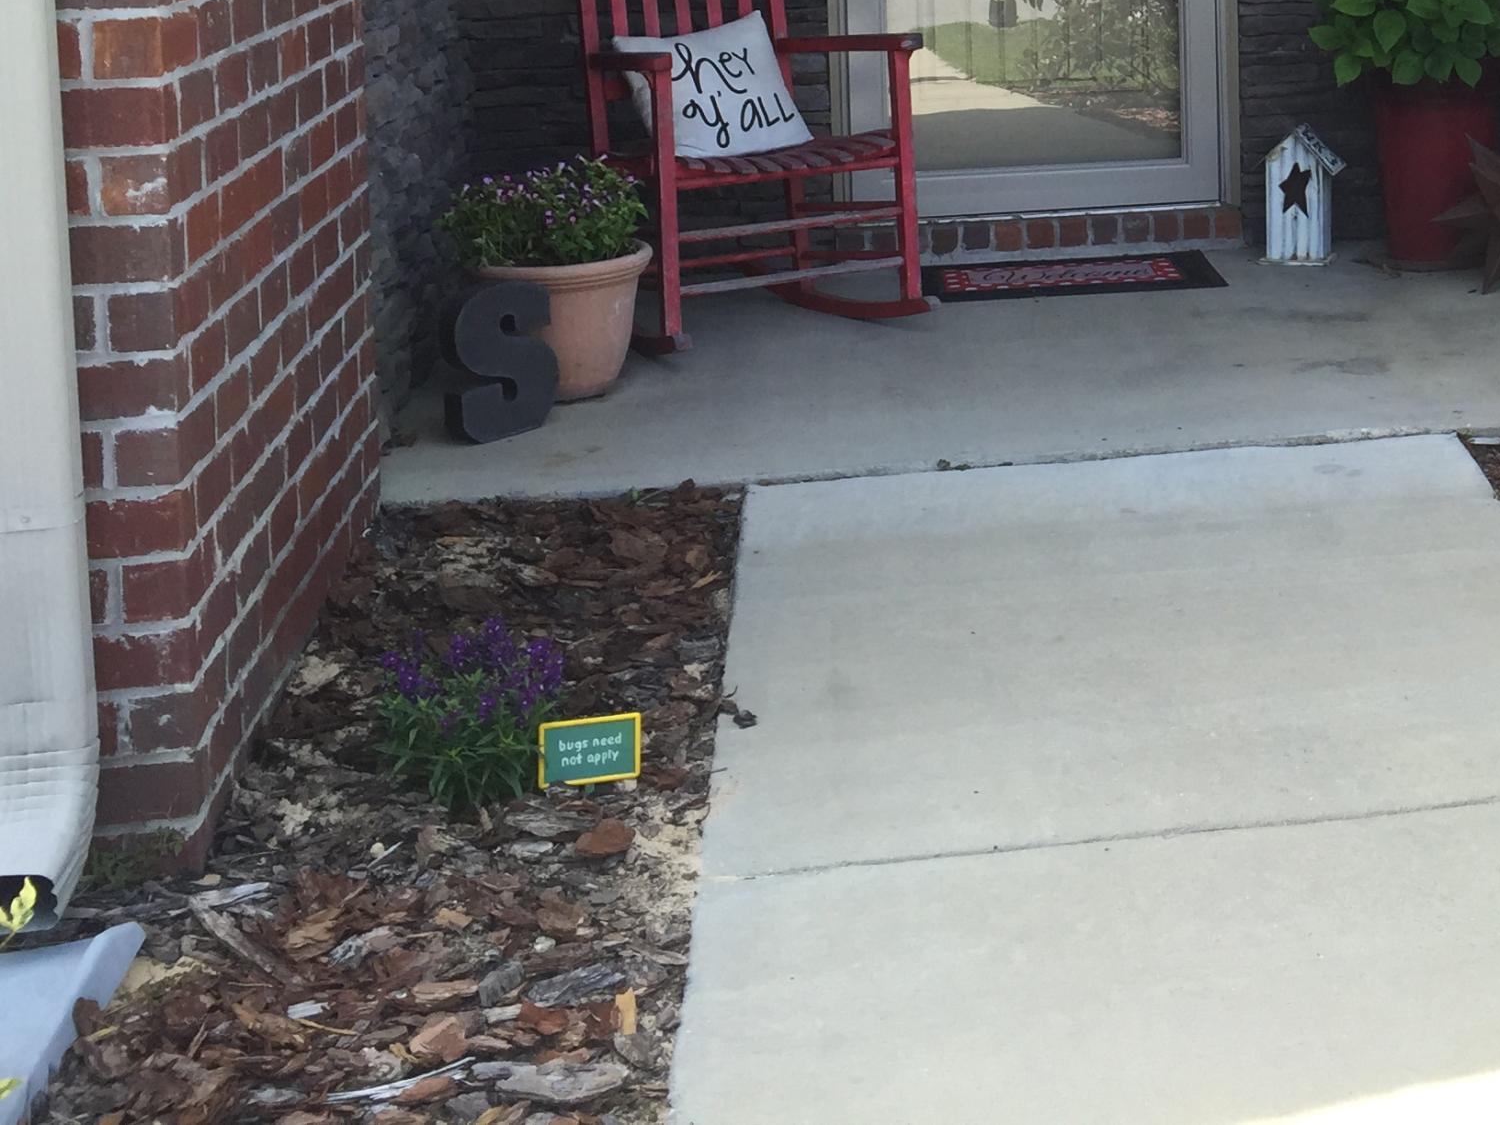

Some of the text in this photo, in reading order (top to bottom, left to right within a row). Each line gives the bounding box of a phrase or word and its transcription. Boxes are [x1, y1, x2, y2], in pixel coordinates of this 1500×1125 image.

[672, 42, 755, 94] hey
[450, 279, 560, 444] S
[558, 732, 623, 752] bugs need
[561, 749, 620, 767] not apply
